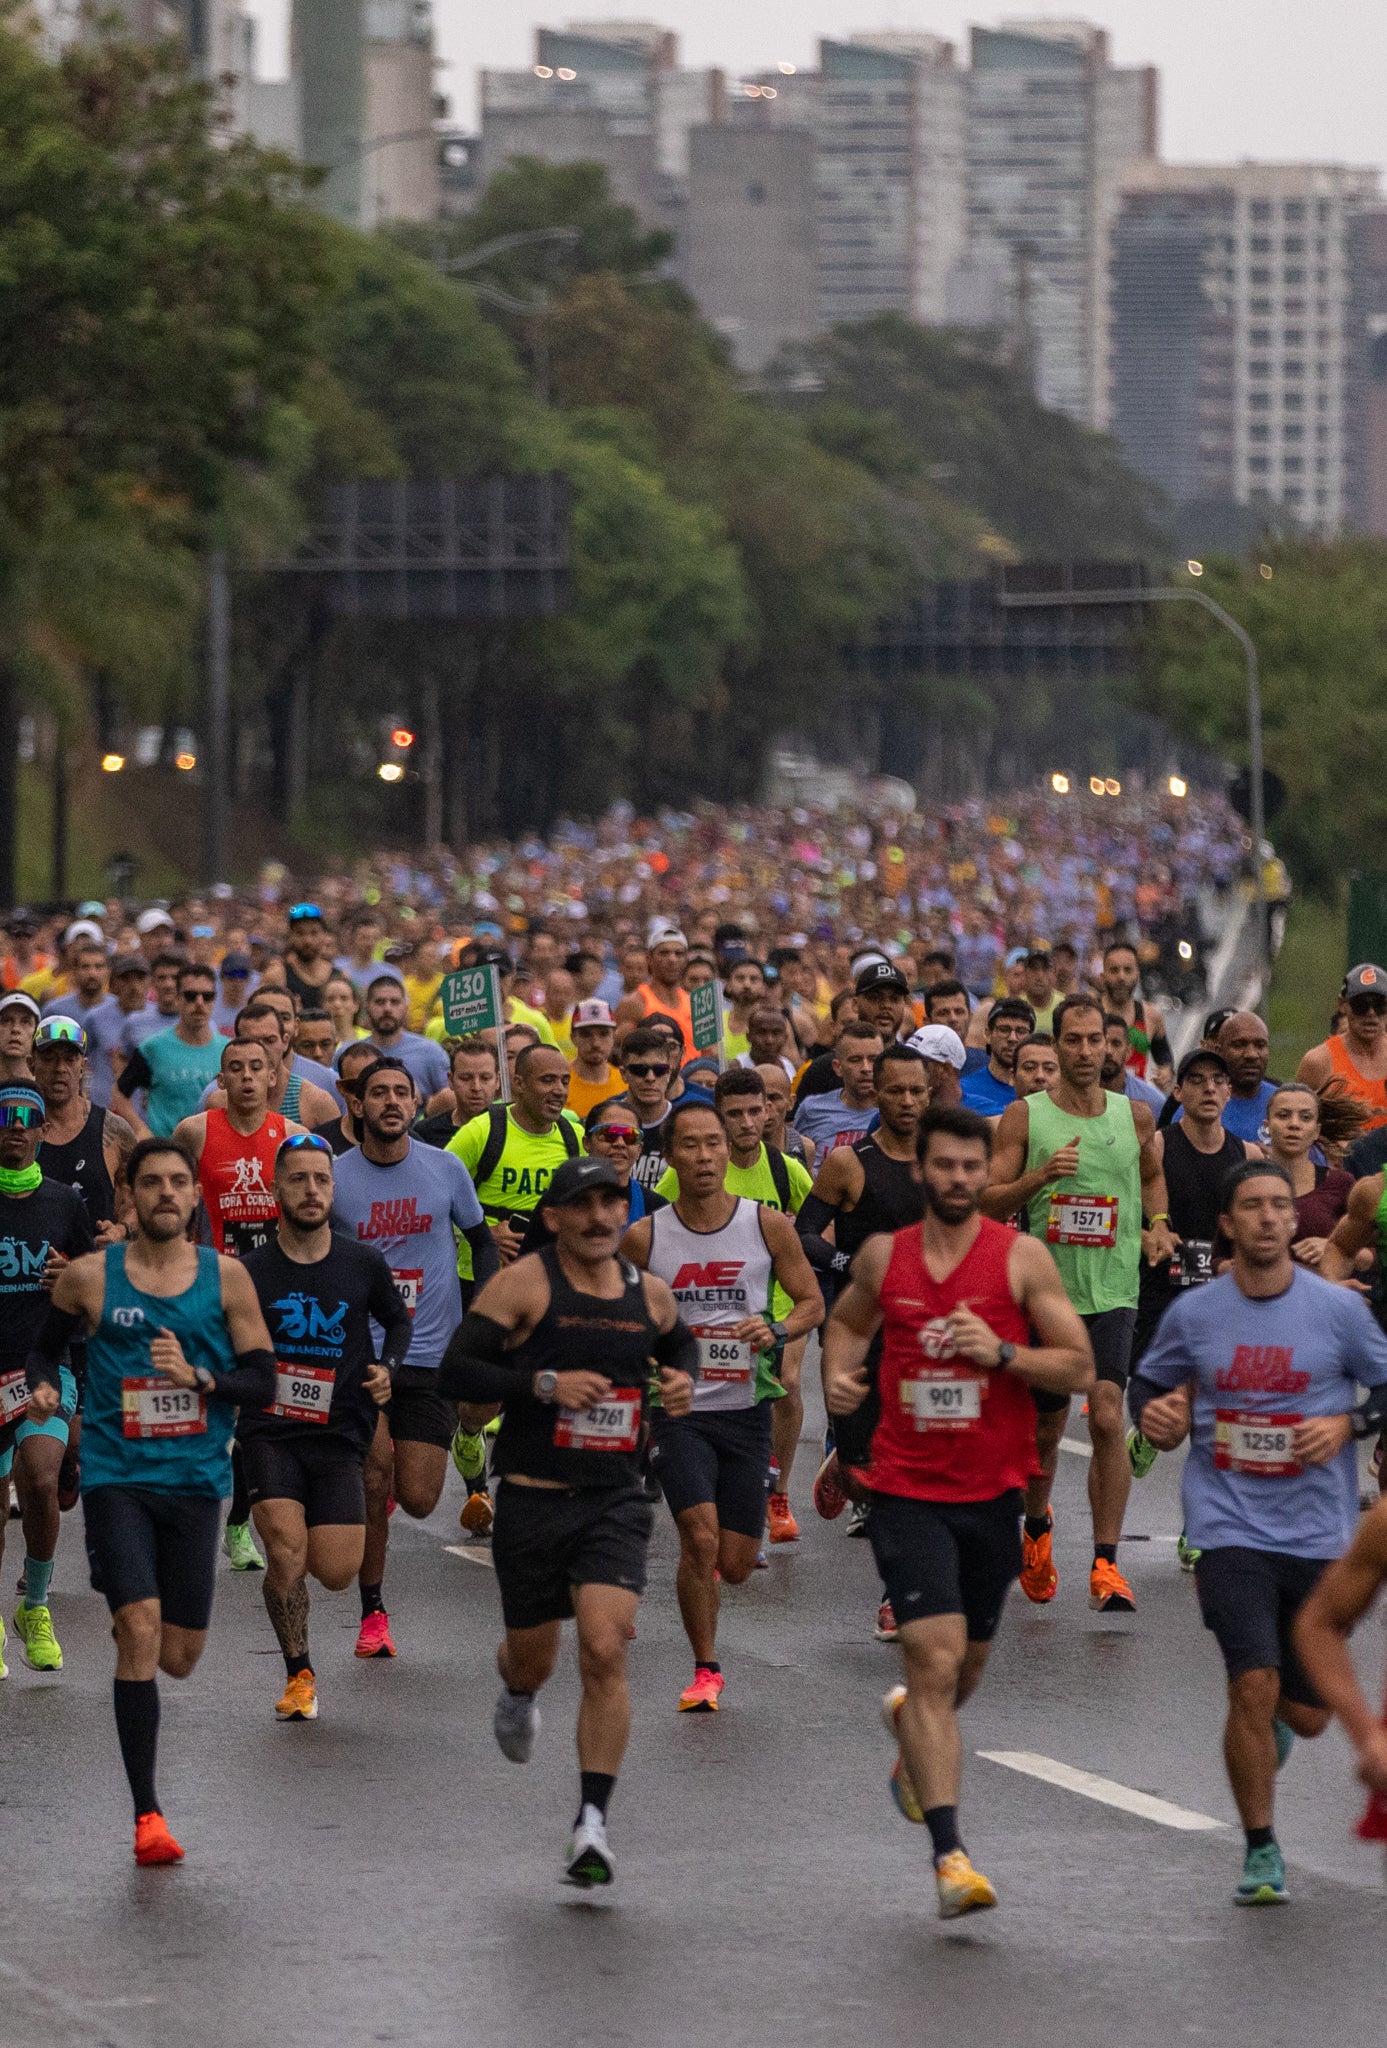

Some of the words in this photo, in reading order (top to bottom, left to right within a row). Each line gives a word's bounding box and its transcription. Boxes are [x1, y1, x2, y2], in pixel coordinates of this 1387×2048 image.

[448, 972, 485, 1002] 1:30
[693, 987, 713, 1017] 1:30
[833, 1130, 868, 1150] RU
[370, 1197, 417, 1224] RUN
[1071, 1210, 1104, 1227] 1571
[358, 1214, 433, 1240] LONGER
[672, 1289, 747, 1302] NALETTO
[702, 1302, 746, 1312] ESPORTES
[709, 1343, 740, 1360] 866
[1231, 1344, 1295, 1373] RUN
[1215, 1367, 1311, 1394] LONGER
[291, 1381, 321, 1401] 988
[928, 1387, 963, 1407] 901
[151, 1393, 192, 1413] 1513
[587, 1407, 625, 1426] 4761
[1242, 1432, 1286, 1451] 1258
